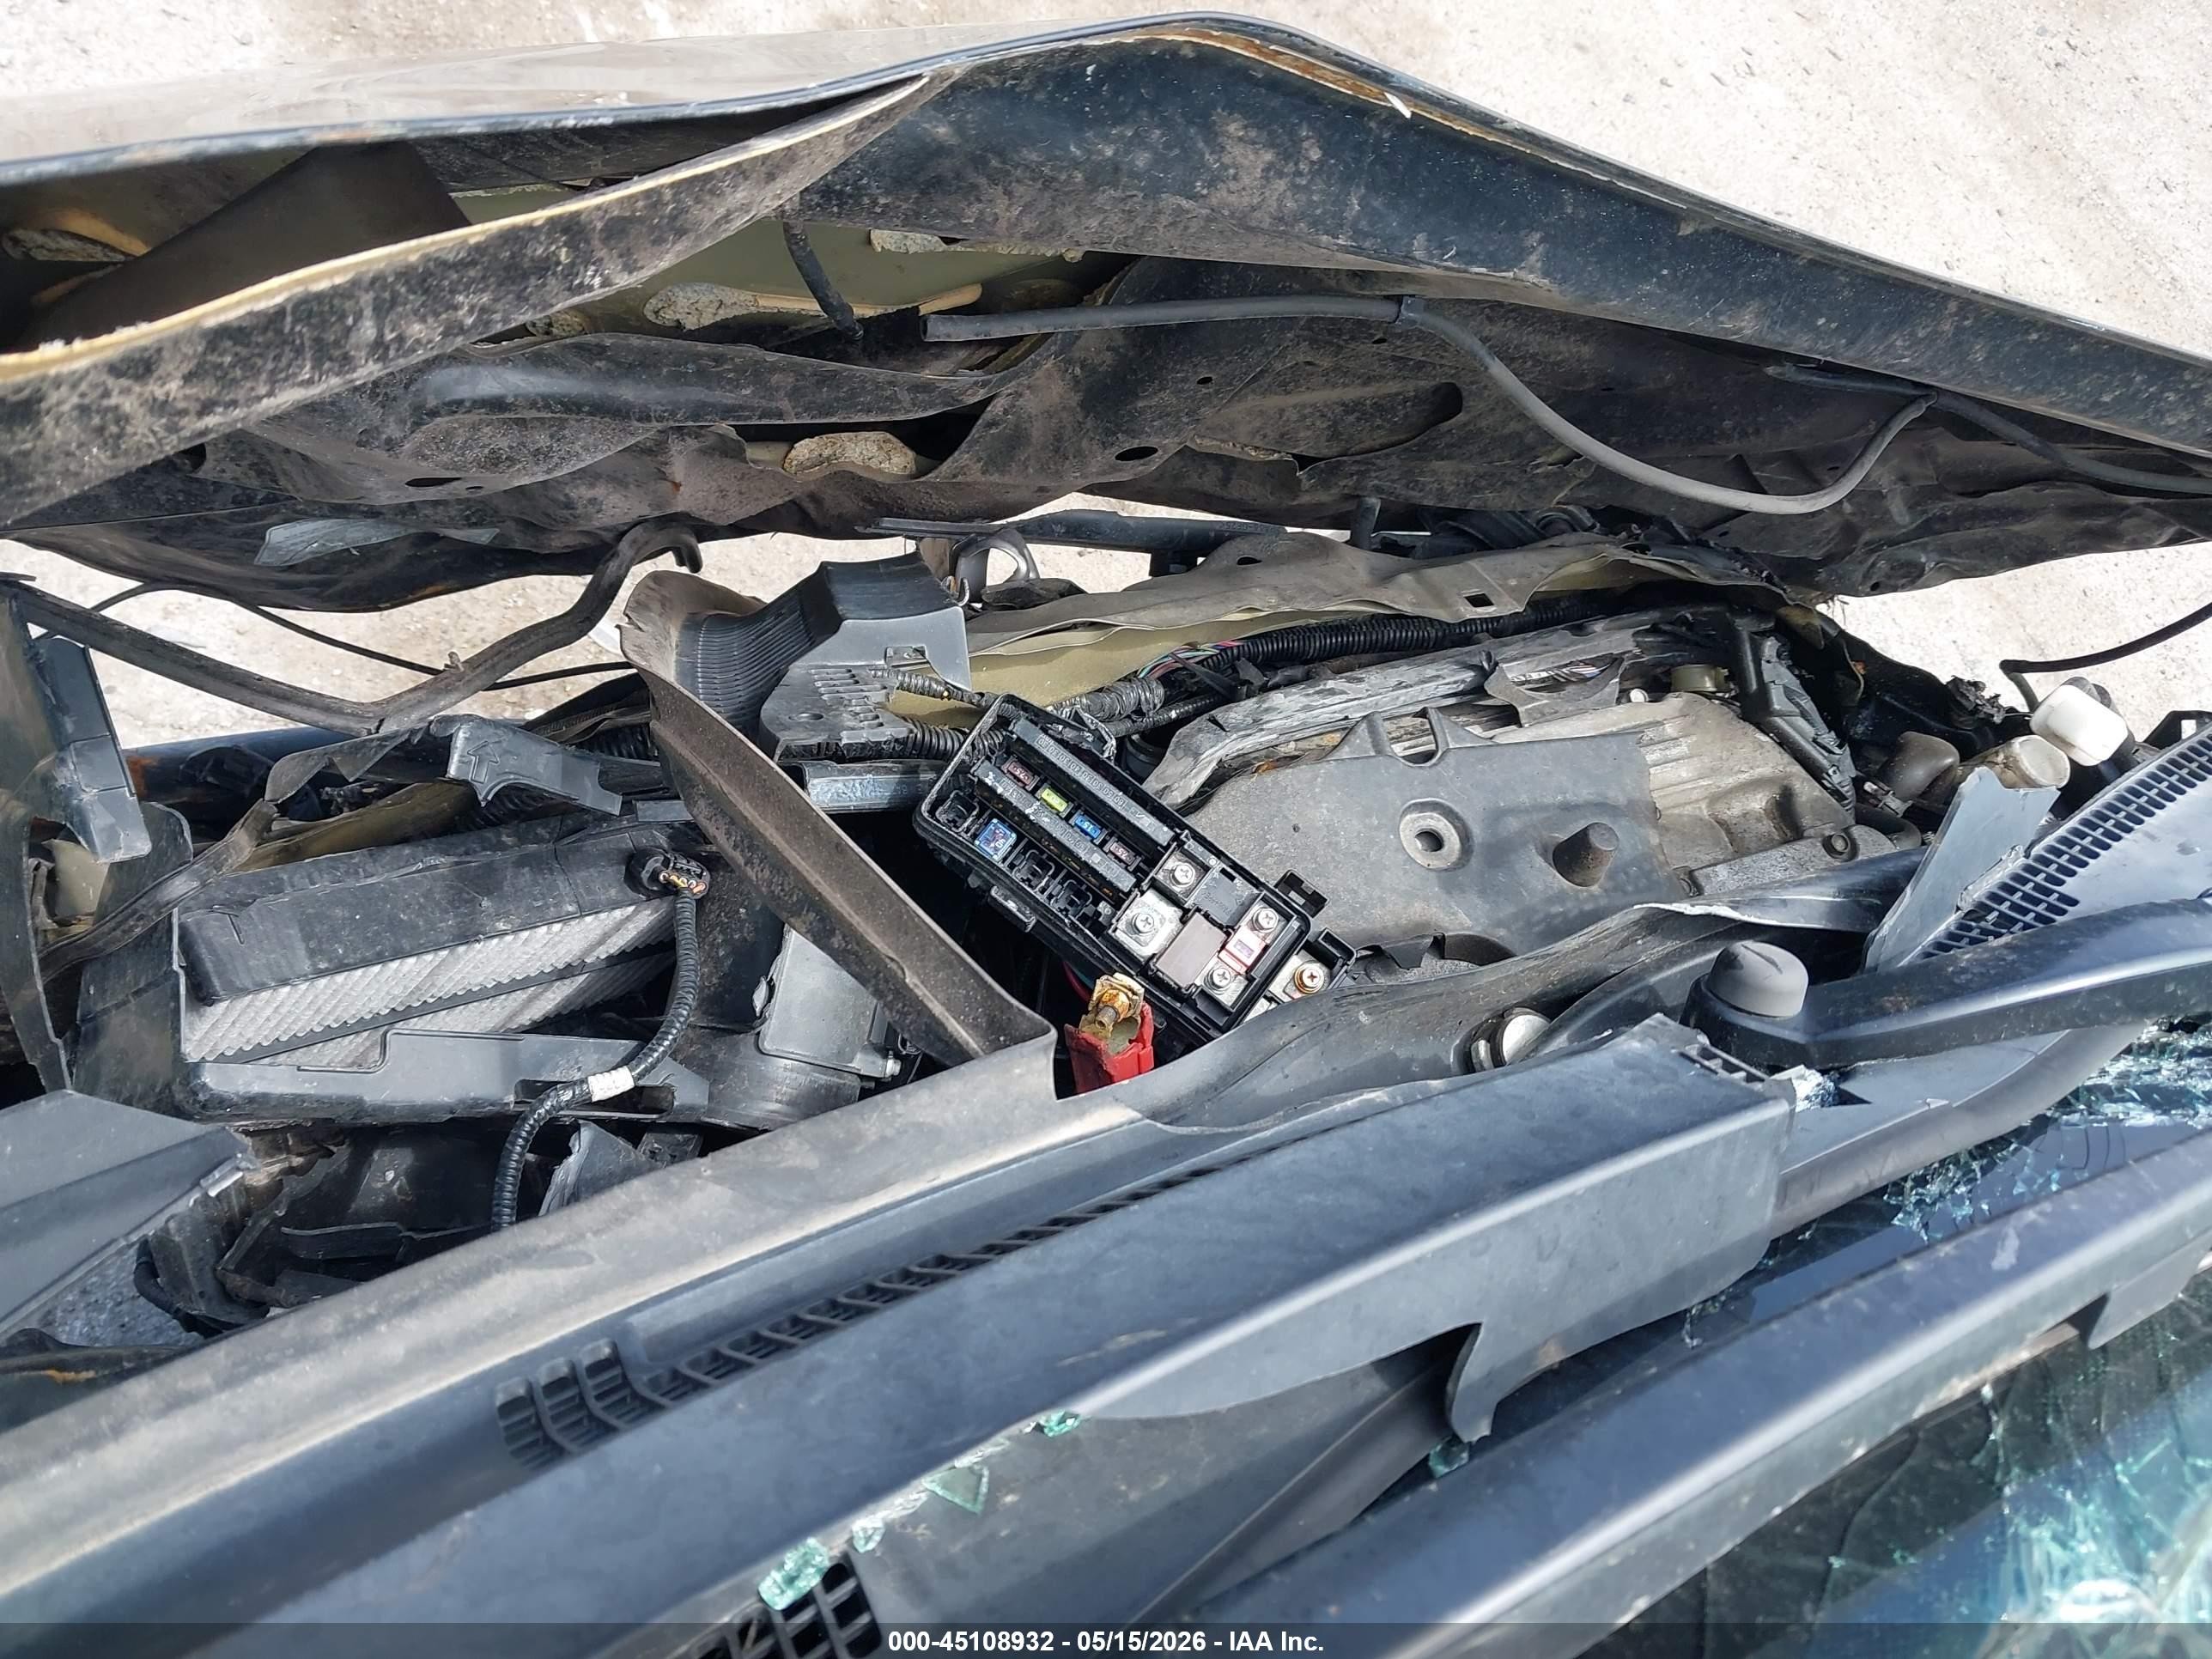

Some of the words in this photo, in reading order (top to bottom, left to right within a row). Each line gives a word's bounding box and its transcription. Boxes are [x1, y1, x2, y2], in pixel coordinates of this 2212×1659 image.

[1060, 755, 1068, 764] 30
[1070, 763, 1080, 772] 40
[1082, 773, 1091, 782] 30
[1085, 822, 1094, 831] 15
